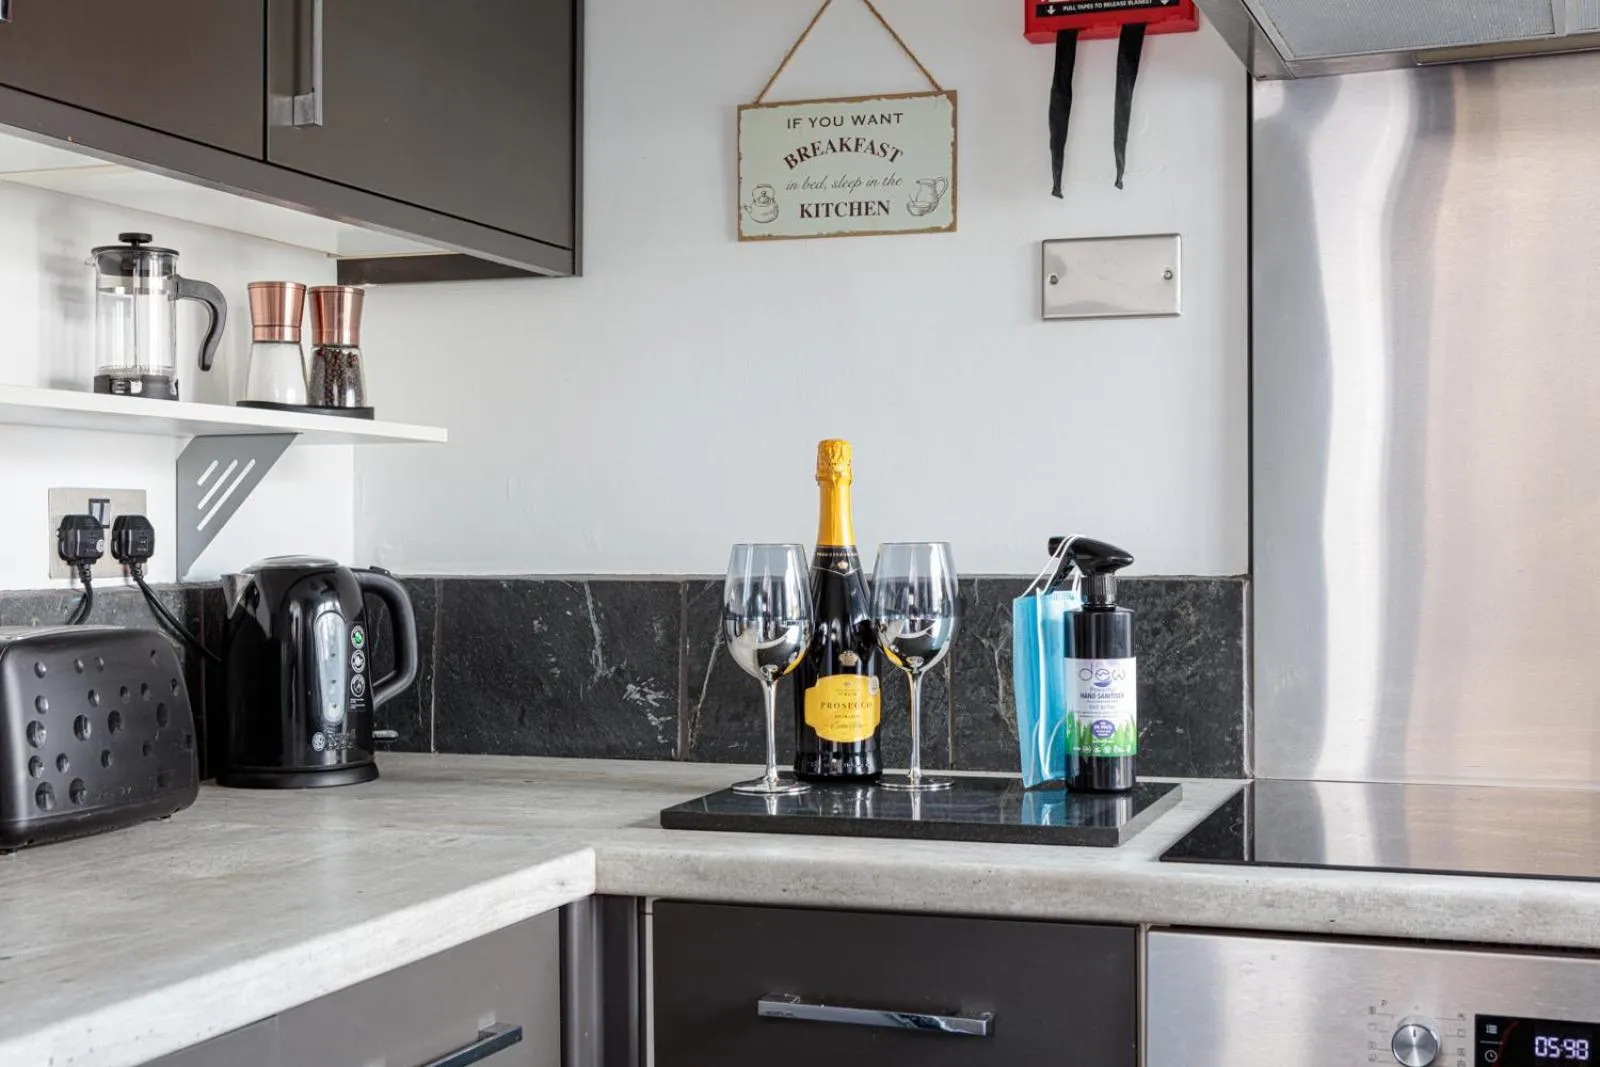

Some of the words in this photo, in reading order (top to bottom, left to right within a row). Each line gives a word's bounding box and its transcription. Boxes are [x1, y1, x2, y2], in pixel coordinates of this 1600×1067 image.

[787, 117, 803, 129] IF
[808, 115, 845, 128] YOU
[850, 112, 904, 126] WANT
[783, 136, 904, 170] BREAKFAST
[785, 180, 798, 191] in
[802, 176, 828, 191] bed,
[831, 174, 862, 194] sleep
[865, 177, 878, 187] in
[882, 171, 903, 187] the
[799, 200, 891, 219] KITCHEN
[820, 701, 873, 710] PROSECCO
